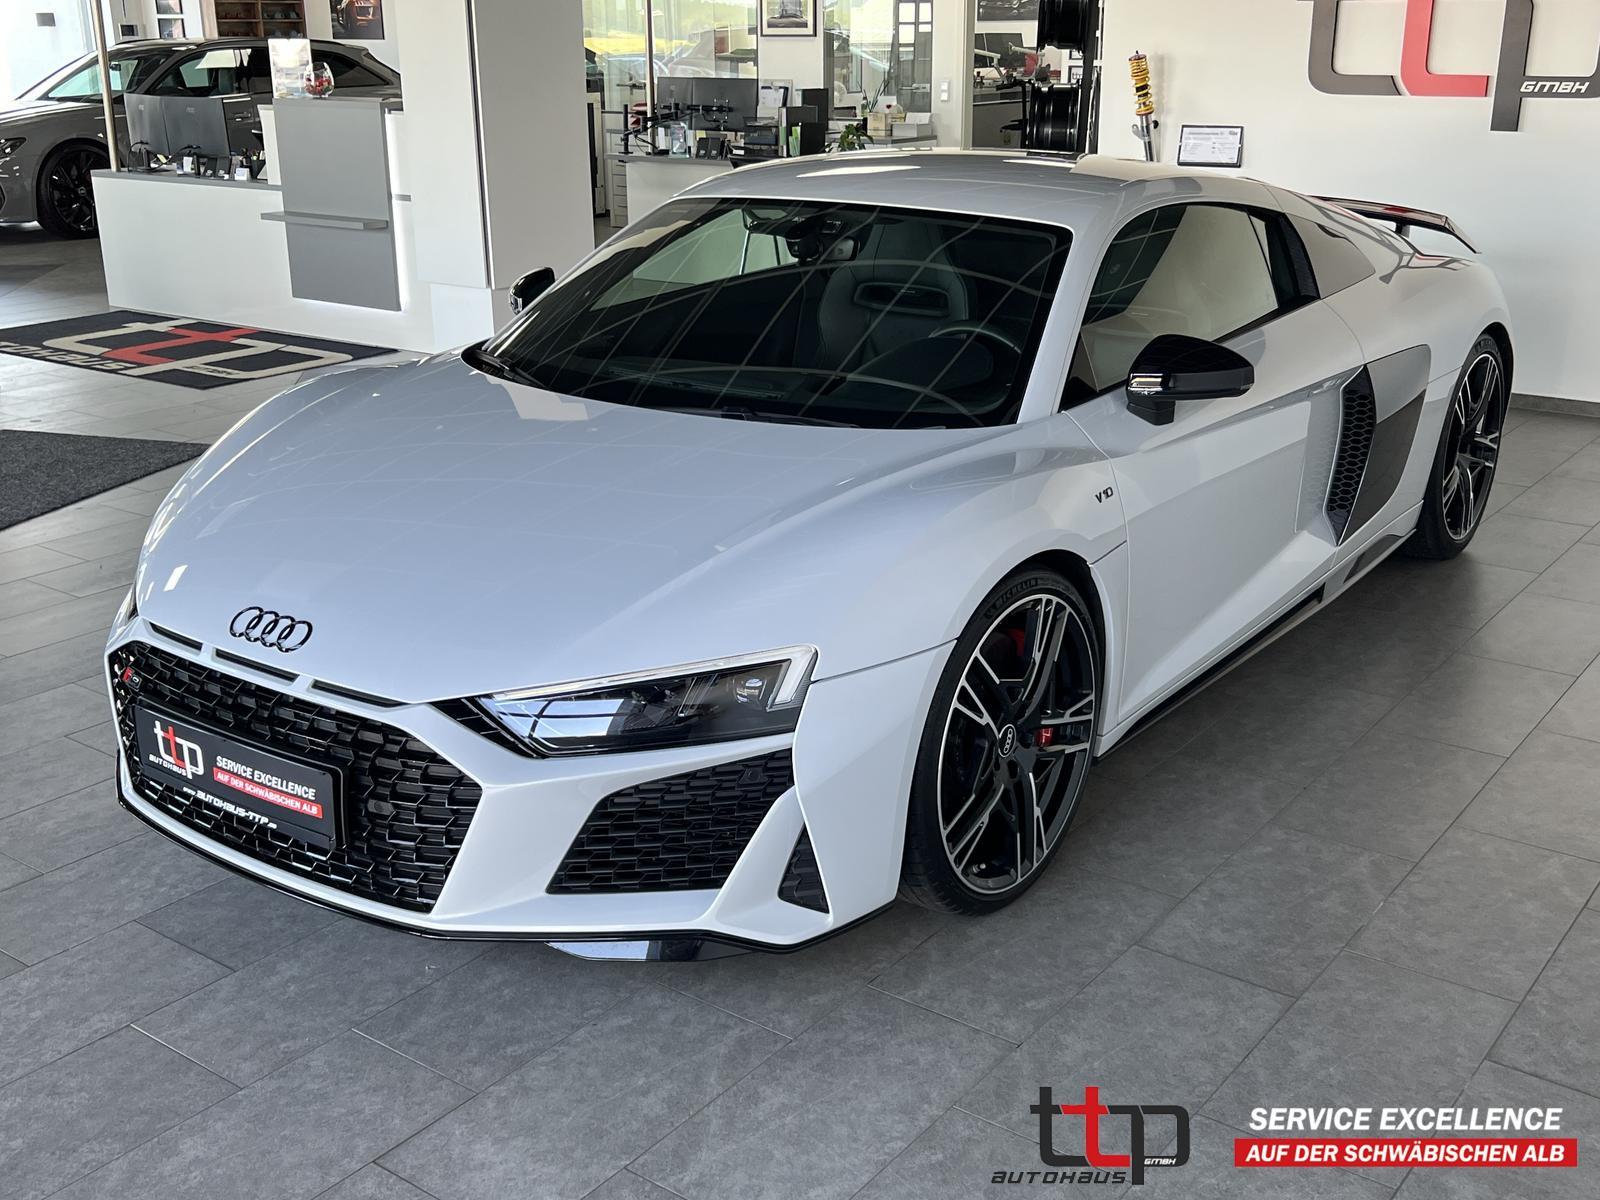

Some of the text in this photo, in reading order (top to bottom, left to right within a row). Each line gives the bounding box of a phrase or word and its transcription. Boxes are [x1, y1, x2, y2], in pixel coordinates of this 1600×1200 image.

[153, 720, 204, 779] ttp
[216, 755, 317, 800] SERVICE EXCELLENCE
[217, 771, 319, 815] AUF DER SCHWÄBISCHEN ALB
